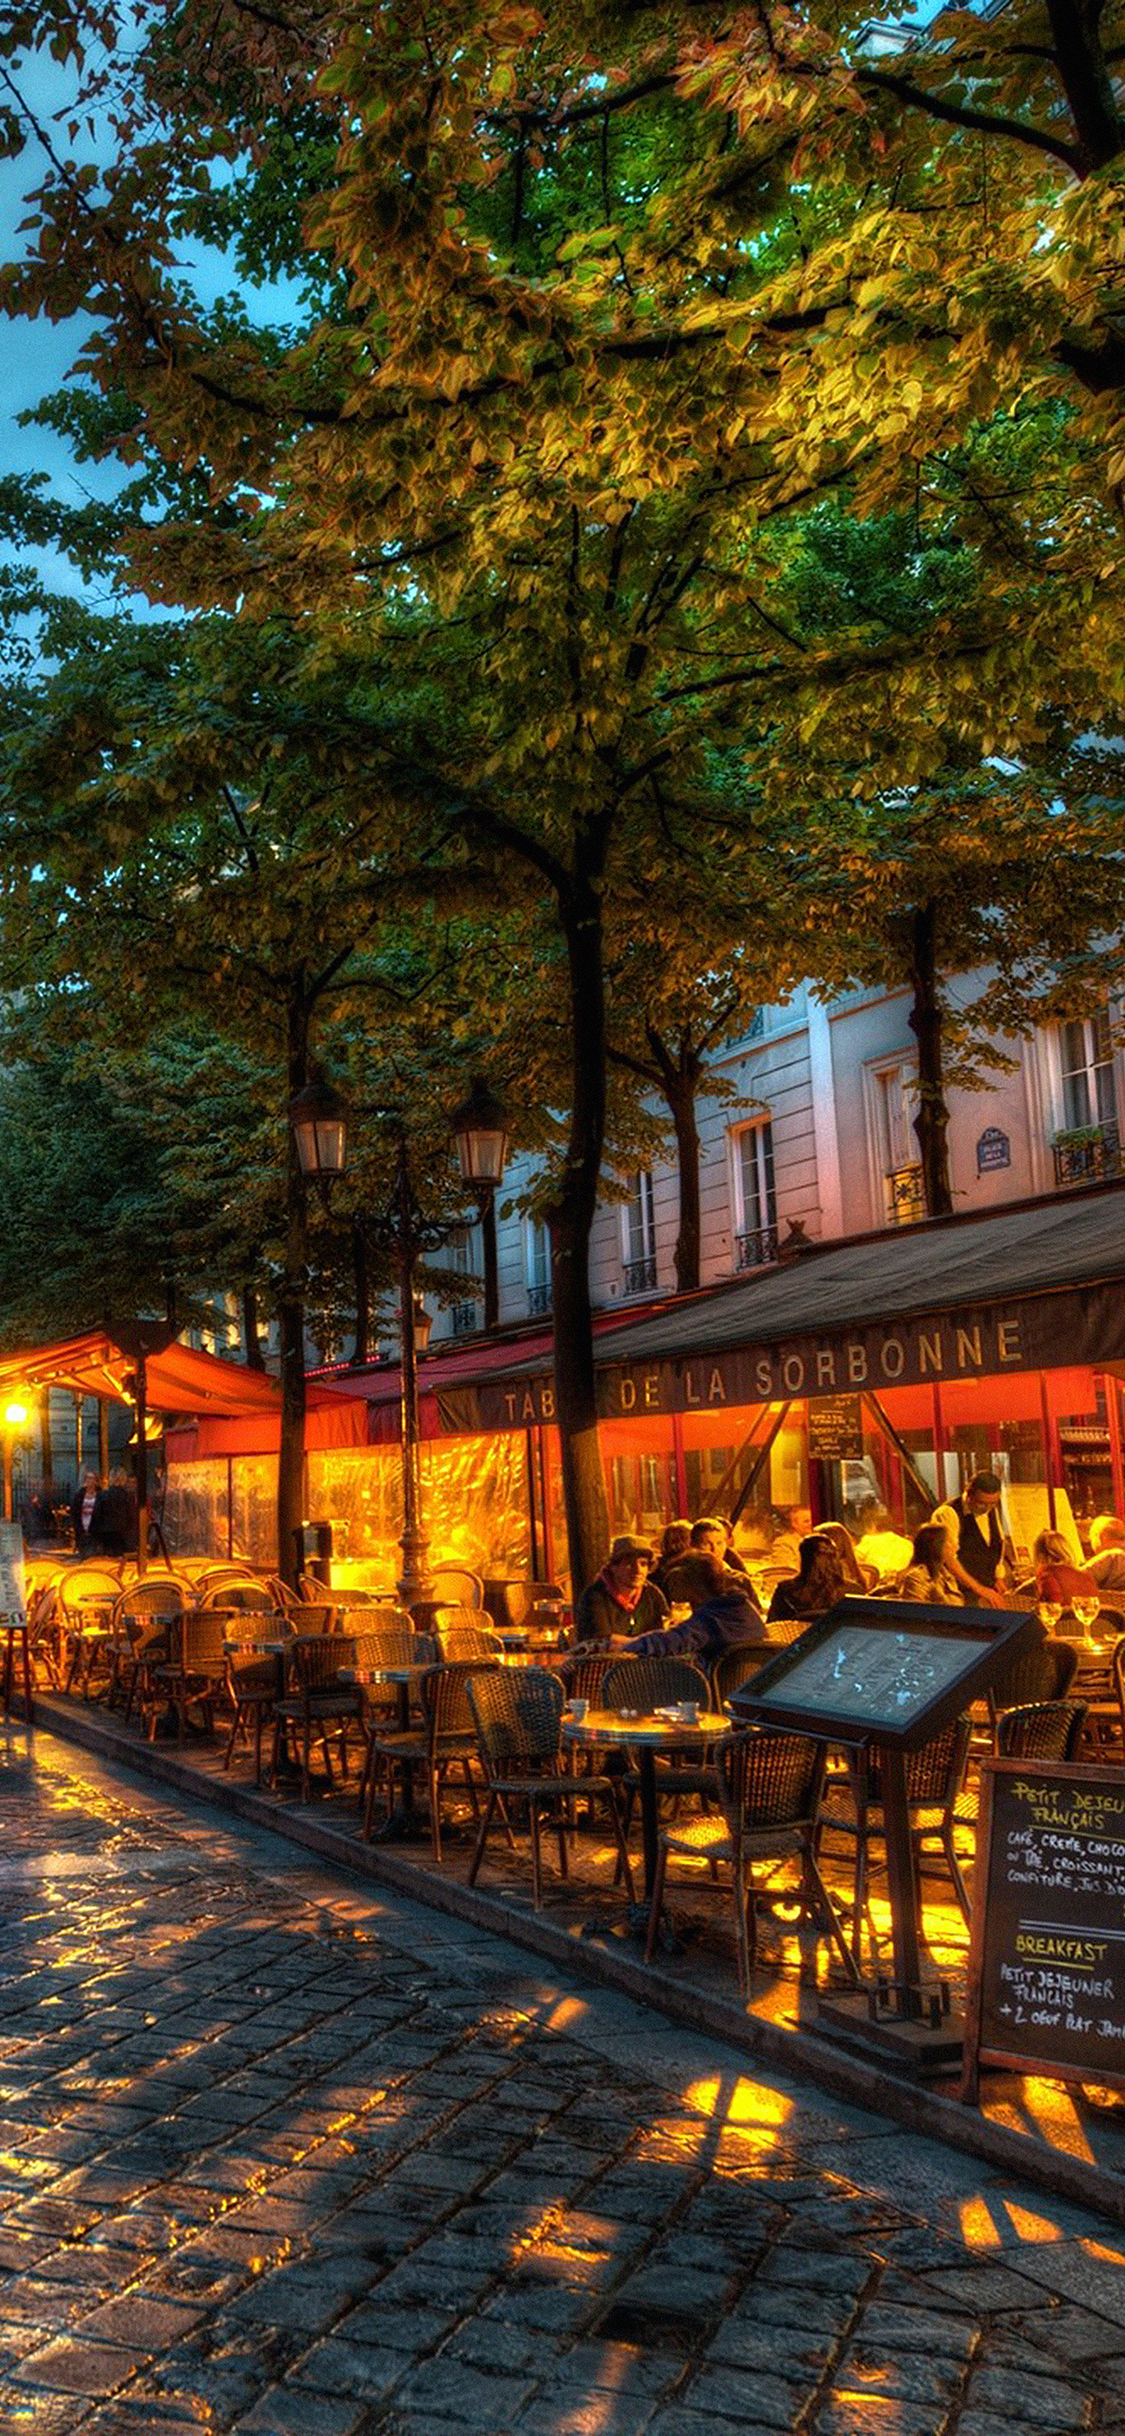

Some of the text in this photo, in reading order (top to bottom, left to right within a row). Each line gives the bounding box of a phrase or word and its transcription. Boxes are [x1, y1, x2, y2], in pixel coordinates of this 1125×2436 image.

[505, 1320, 1022, 1421] TAB DE LA SORBONNE
[1011, 1782, 1060, 1804] PETIT
[1015, 1935, 1108, 1961] BREAKFAST
[1096, 2020, 1125, 2038] JAM
